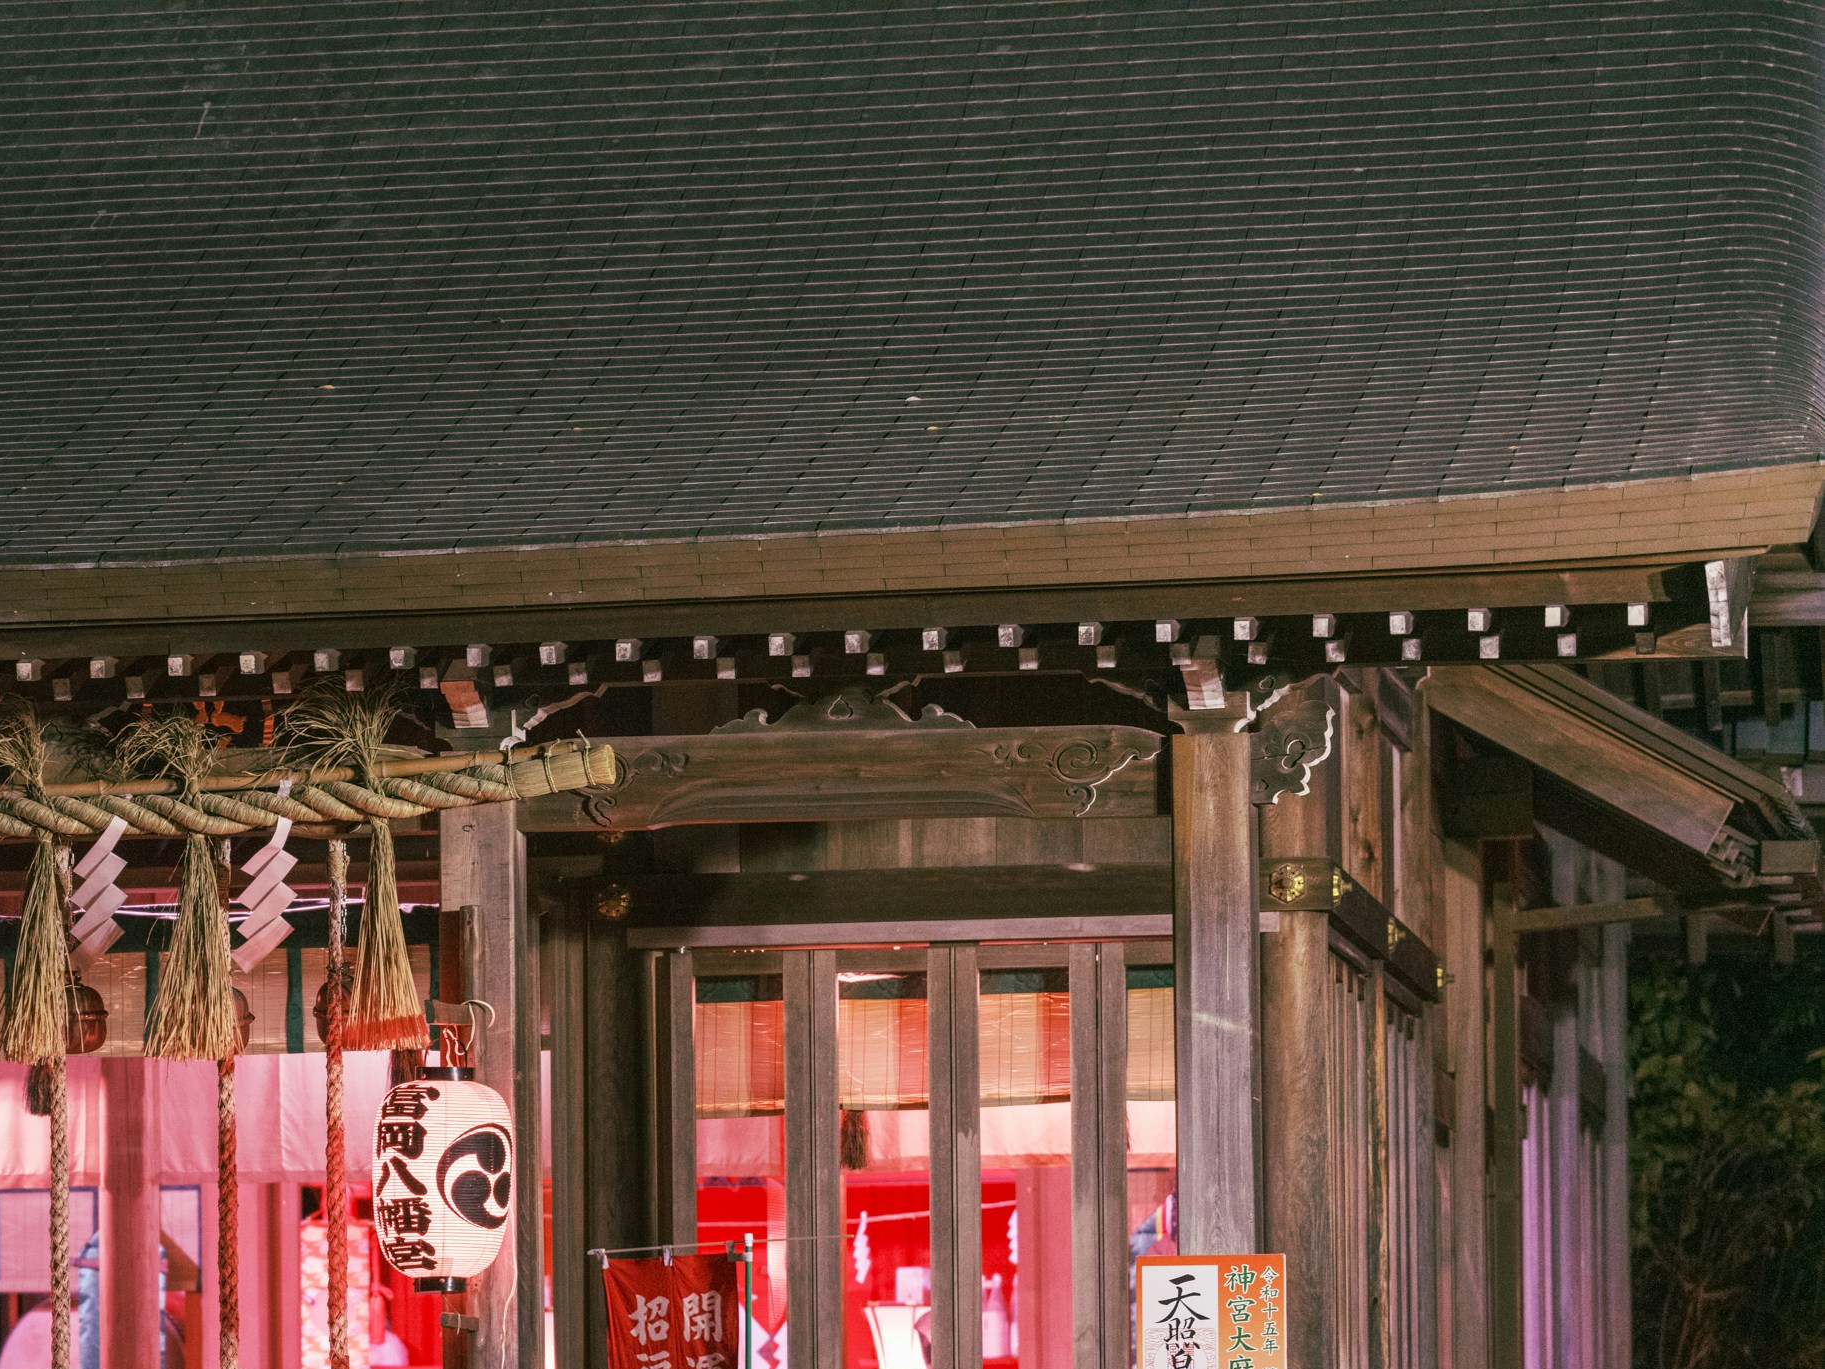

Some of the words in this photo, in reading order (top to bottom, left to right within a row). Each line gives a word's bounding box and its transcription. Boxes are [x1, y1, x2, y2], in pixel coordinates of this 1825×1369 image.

[375, 1084, 440, 1271] 富岡八幡宮
[1259, 1266, 1279, 1355] 令和十五年
